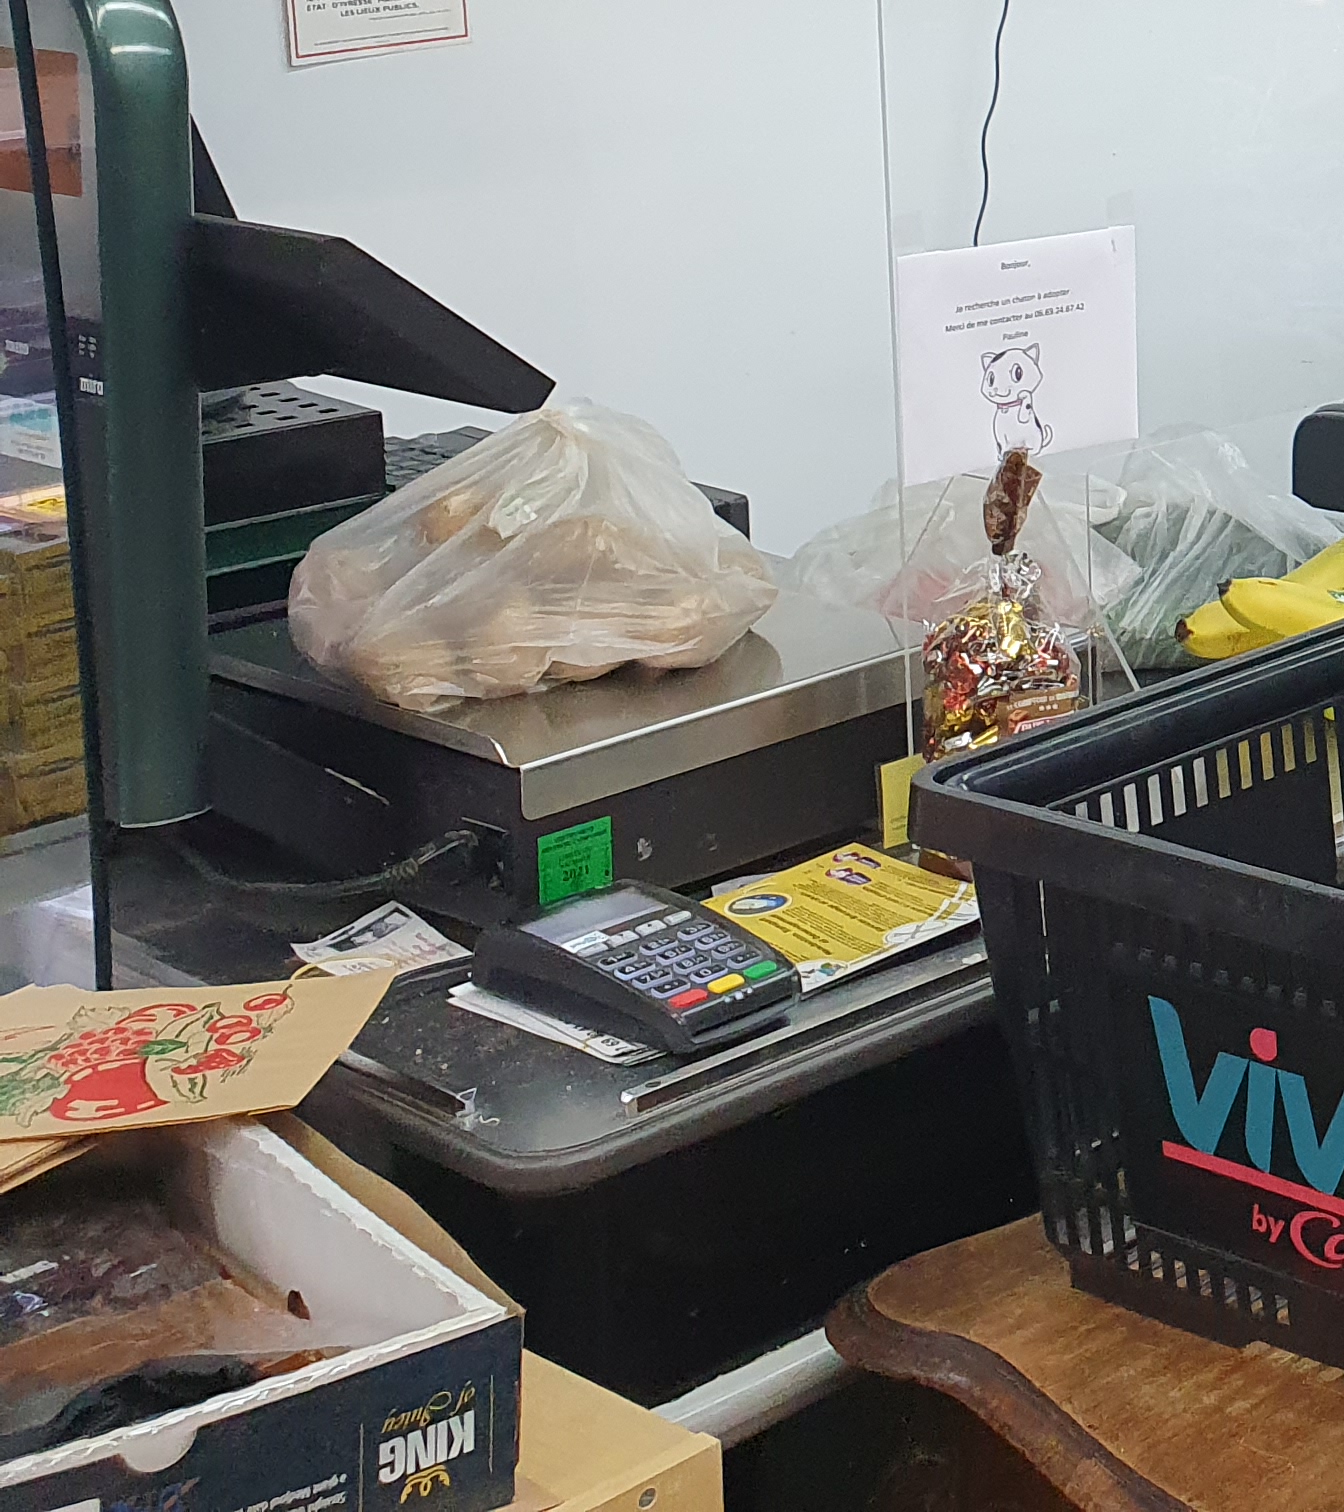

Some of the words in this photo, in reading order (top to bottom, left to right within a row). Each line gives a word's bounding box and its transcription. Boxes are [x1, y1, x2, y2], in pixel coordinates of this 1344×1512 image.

[340, 9, 355, 18] LES
[356, 6, 381, 16] LIEUX
[964, 301, 1000, 312] recherche
[945, 321, 965, 332] Merci
[966, 320, 975, 329] de
[976, 319, 989, 327] me
[989, 313, 1023, 326] contacter
[1024, 312, 1033, 320] au
[1251, 1203, 1286, 1244] by
[378, 1408, 476, 1485] KING
